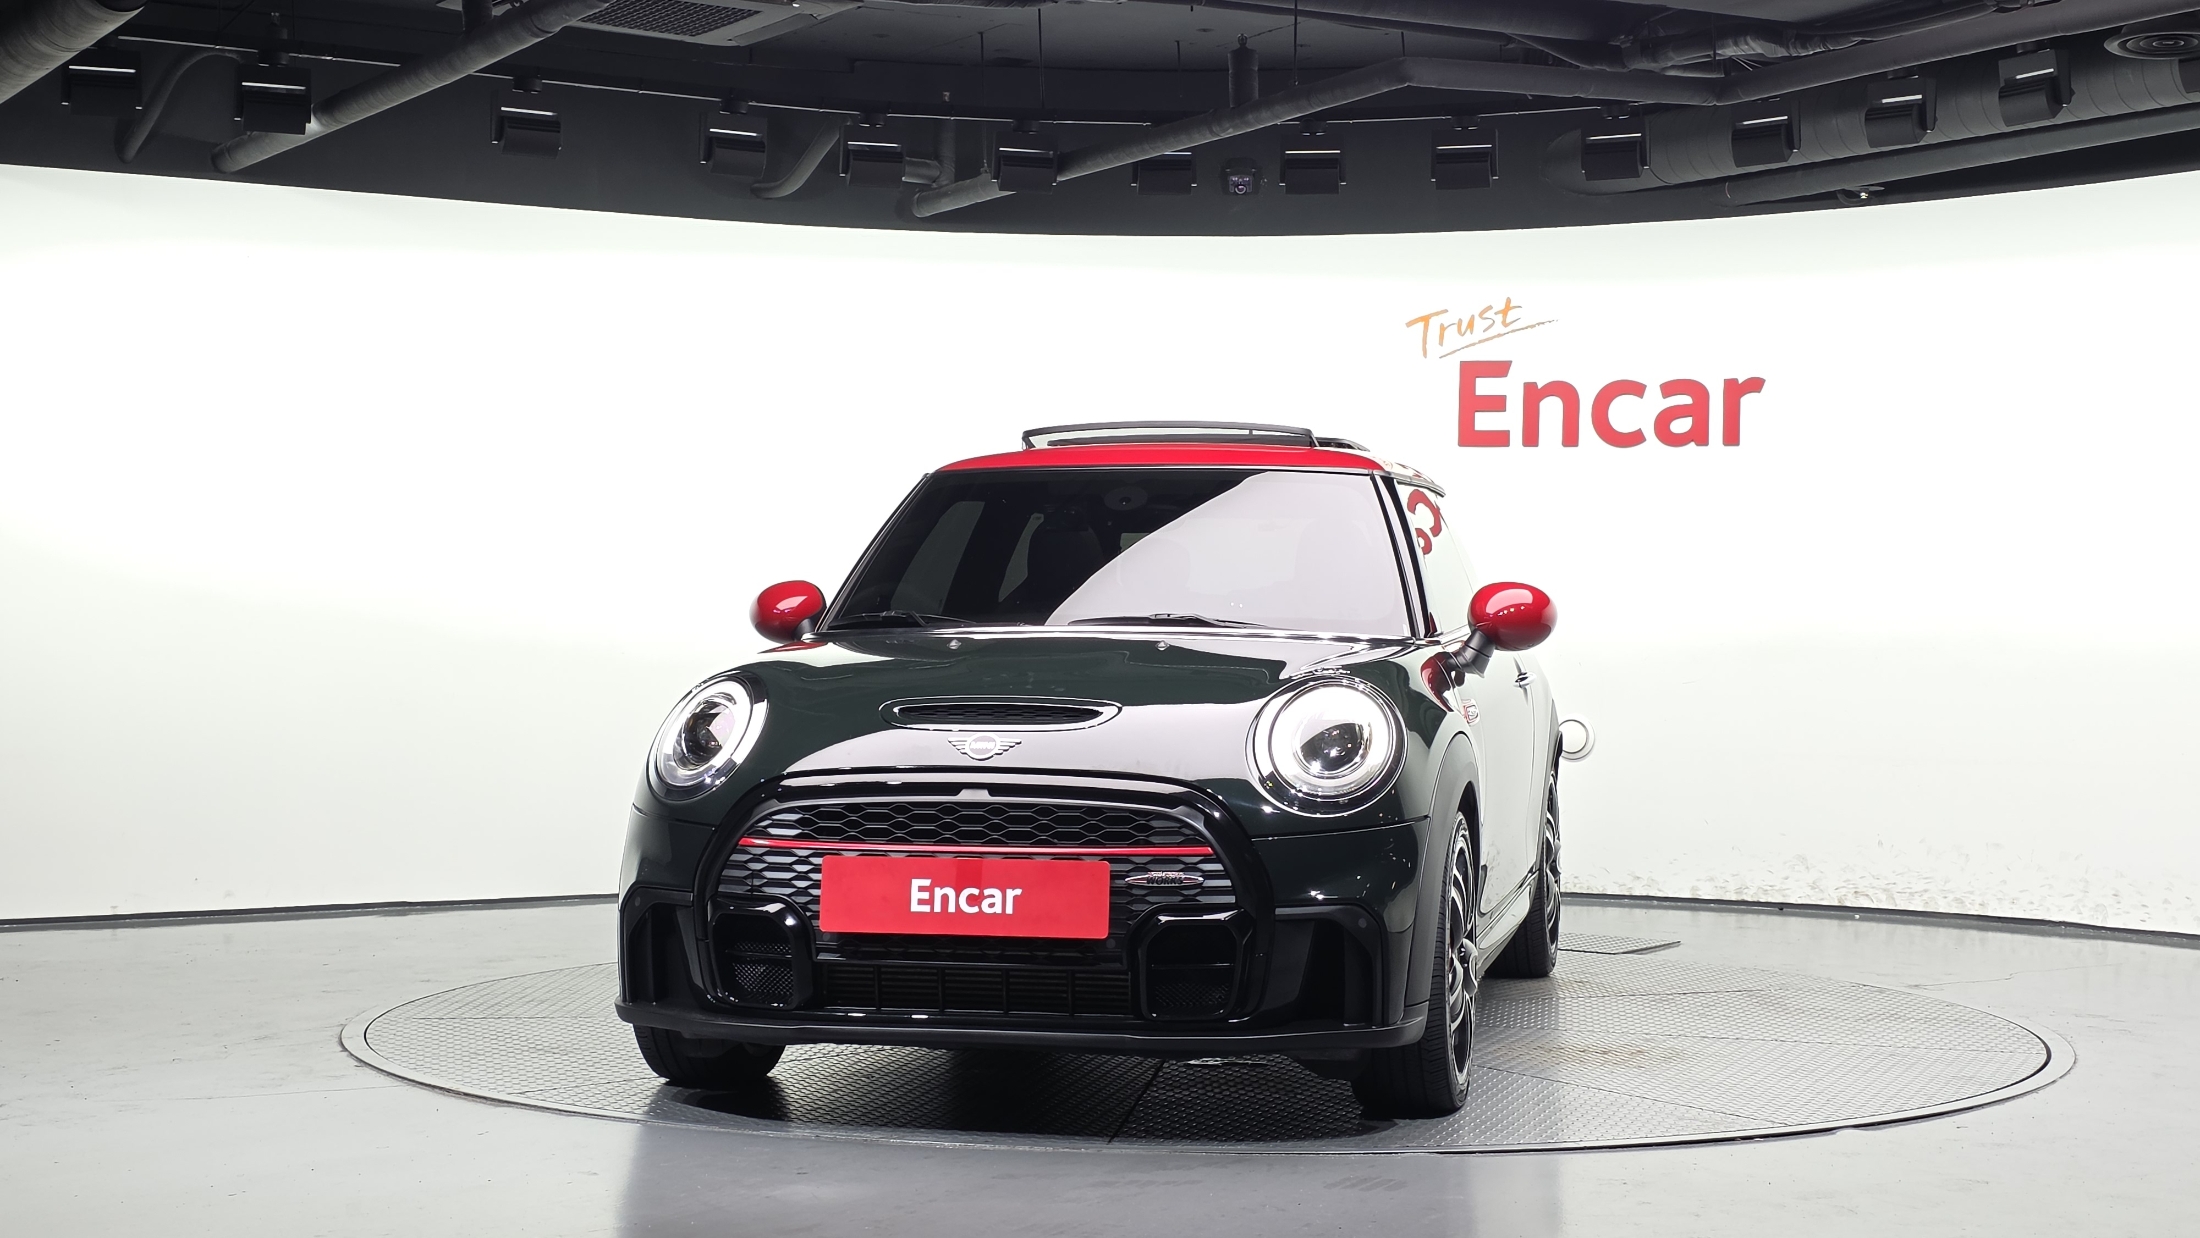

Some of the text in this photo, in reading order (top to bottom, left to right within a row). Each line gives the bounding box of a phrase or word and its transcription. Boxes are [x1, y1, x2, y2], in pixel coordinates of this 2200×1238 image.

[1405, 297, 1522, 359] Trust
[1457, 360, 1766, 449] Encar
[910, 878, 1023, 915] Encar
